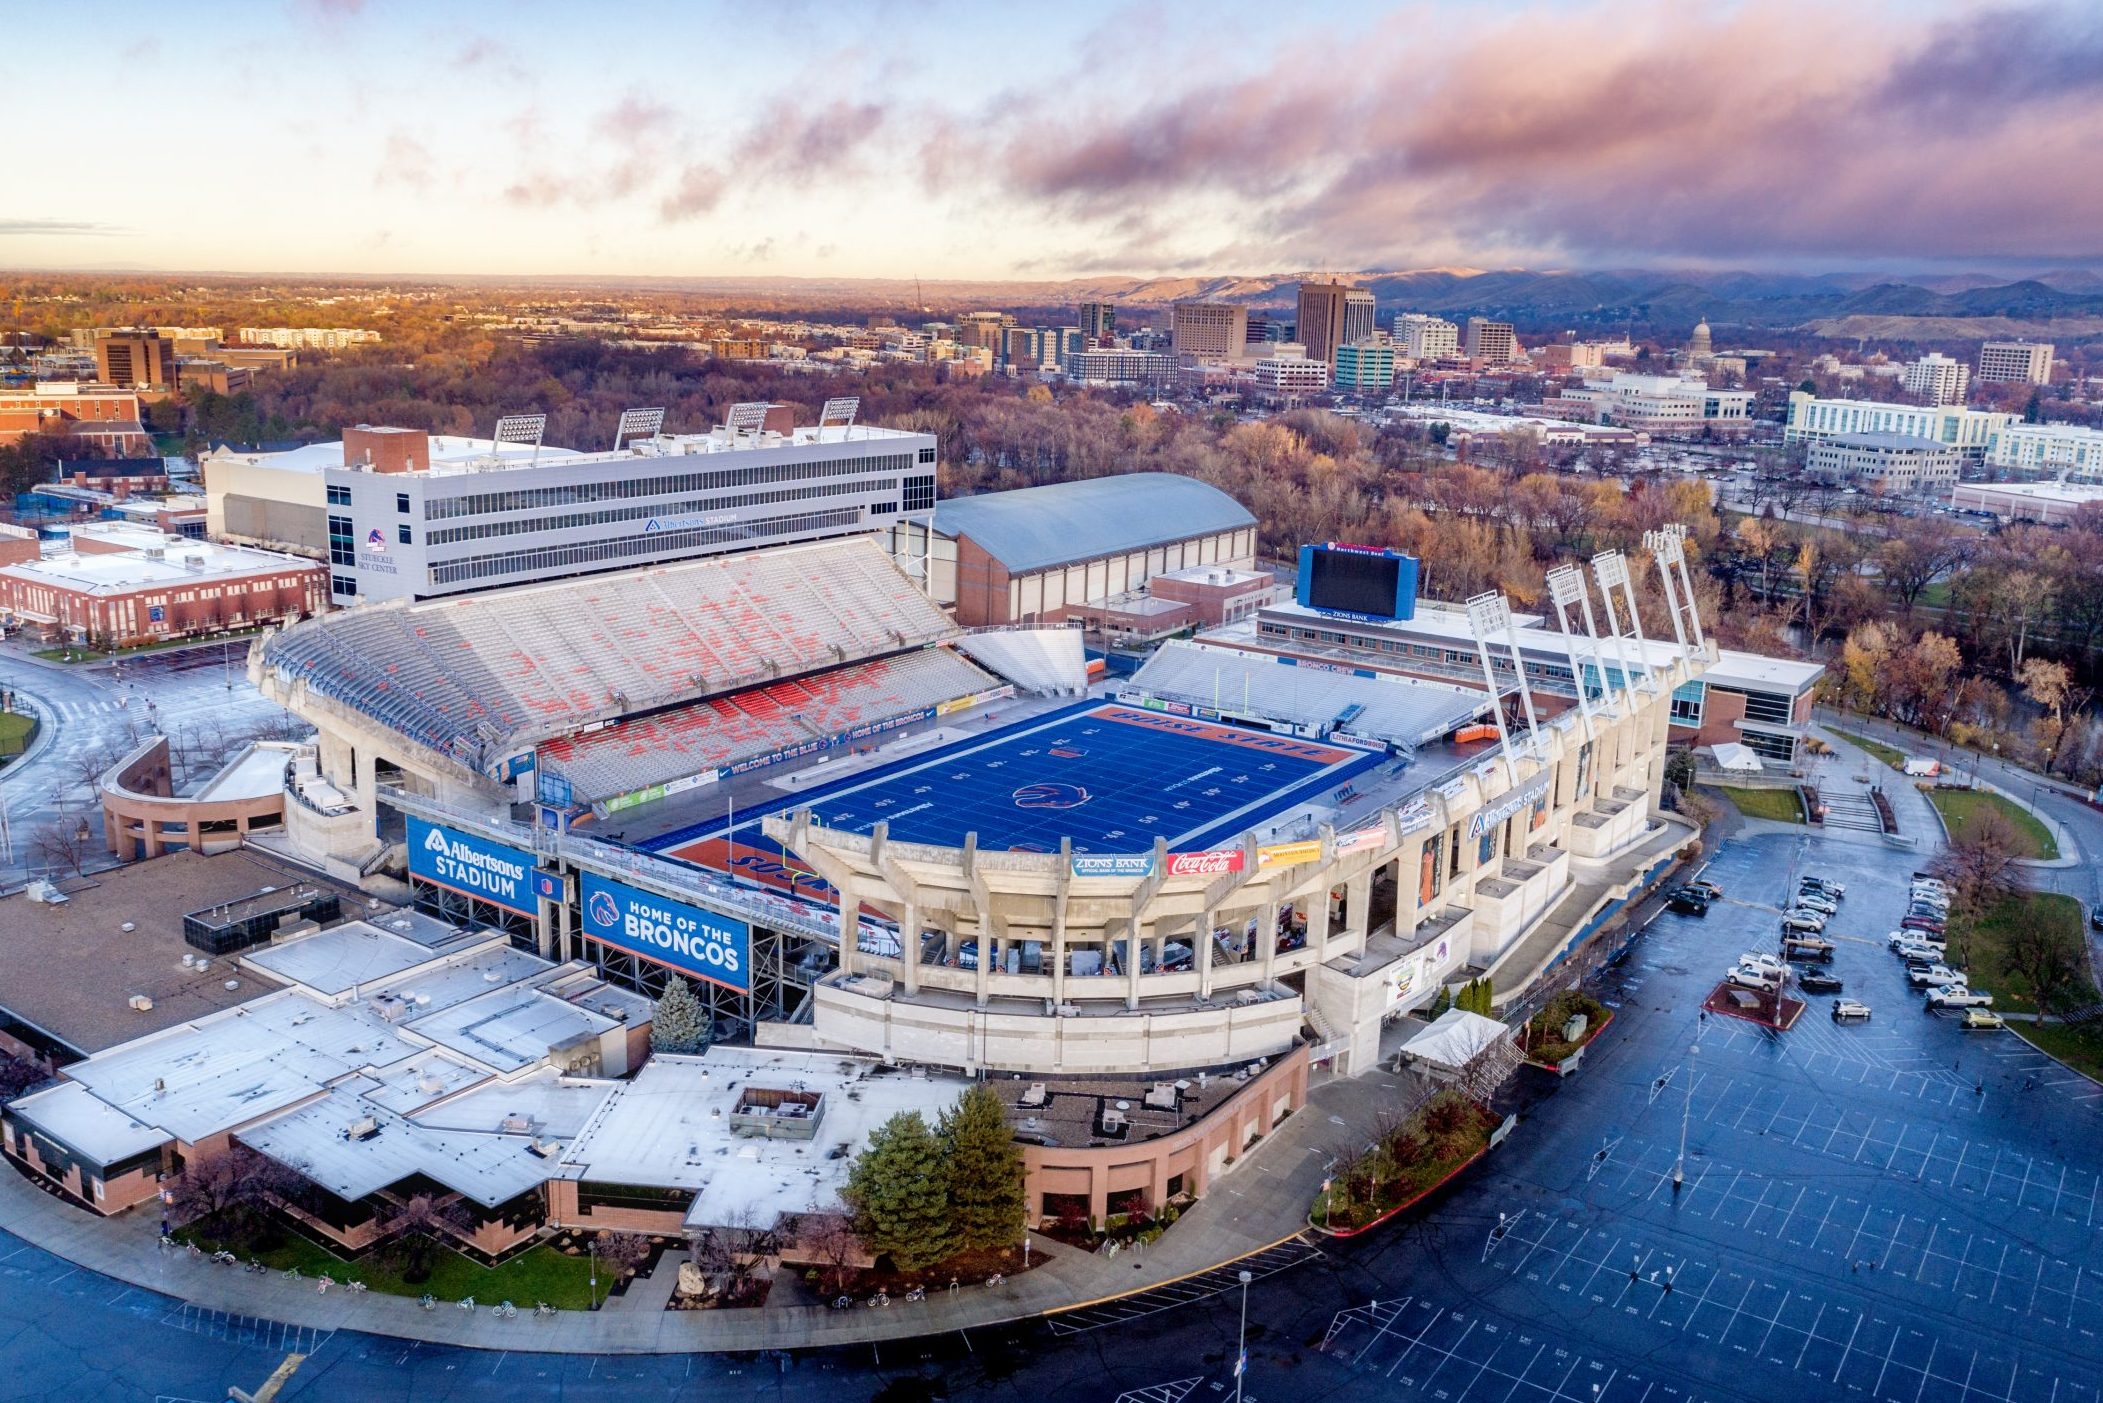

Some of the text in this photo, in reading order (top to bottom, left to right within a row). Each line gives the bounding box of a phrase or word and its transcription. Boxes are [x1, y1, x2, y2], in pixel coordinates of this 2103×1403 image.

[705, 514, 737, 526] STADIUM
[358, 561, 398, 574] SKY CENTER
[361, 553, 394, 564] STUECKLE
[1332, 611, 1368, 622] ZIONS BANK
[1297, 660, 1355, 676] BRONCO CREW
[852, 711, 925, 739] HOME OF THE BRONCOS
[1109, 712, 1333, 756] BOISE STATE
[731, 742, 818, 775] WELCOME TO THE BLUE
[1524, 781, 1550, 806] STADIUM
[451, 841, 524, 880] Albertsons
[1075, 858, 1149, 869] ZIONS BANK
[435, 855, 515, 899] STADIUM
[630, 900, 732, 946] HOME OF THE
[624, 913, 739, 972] BRONCOS
